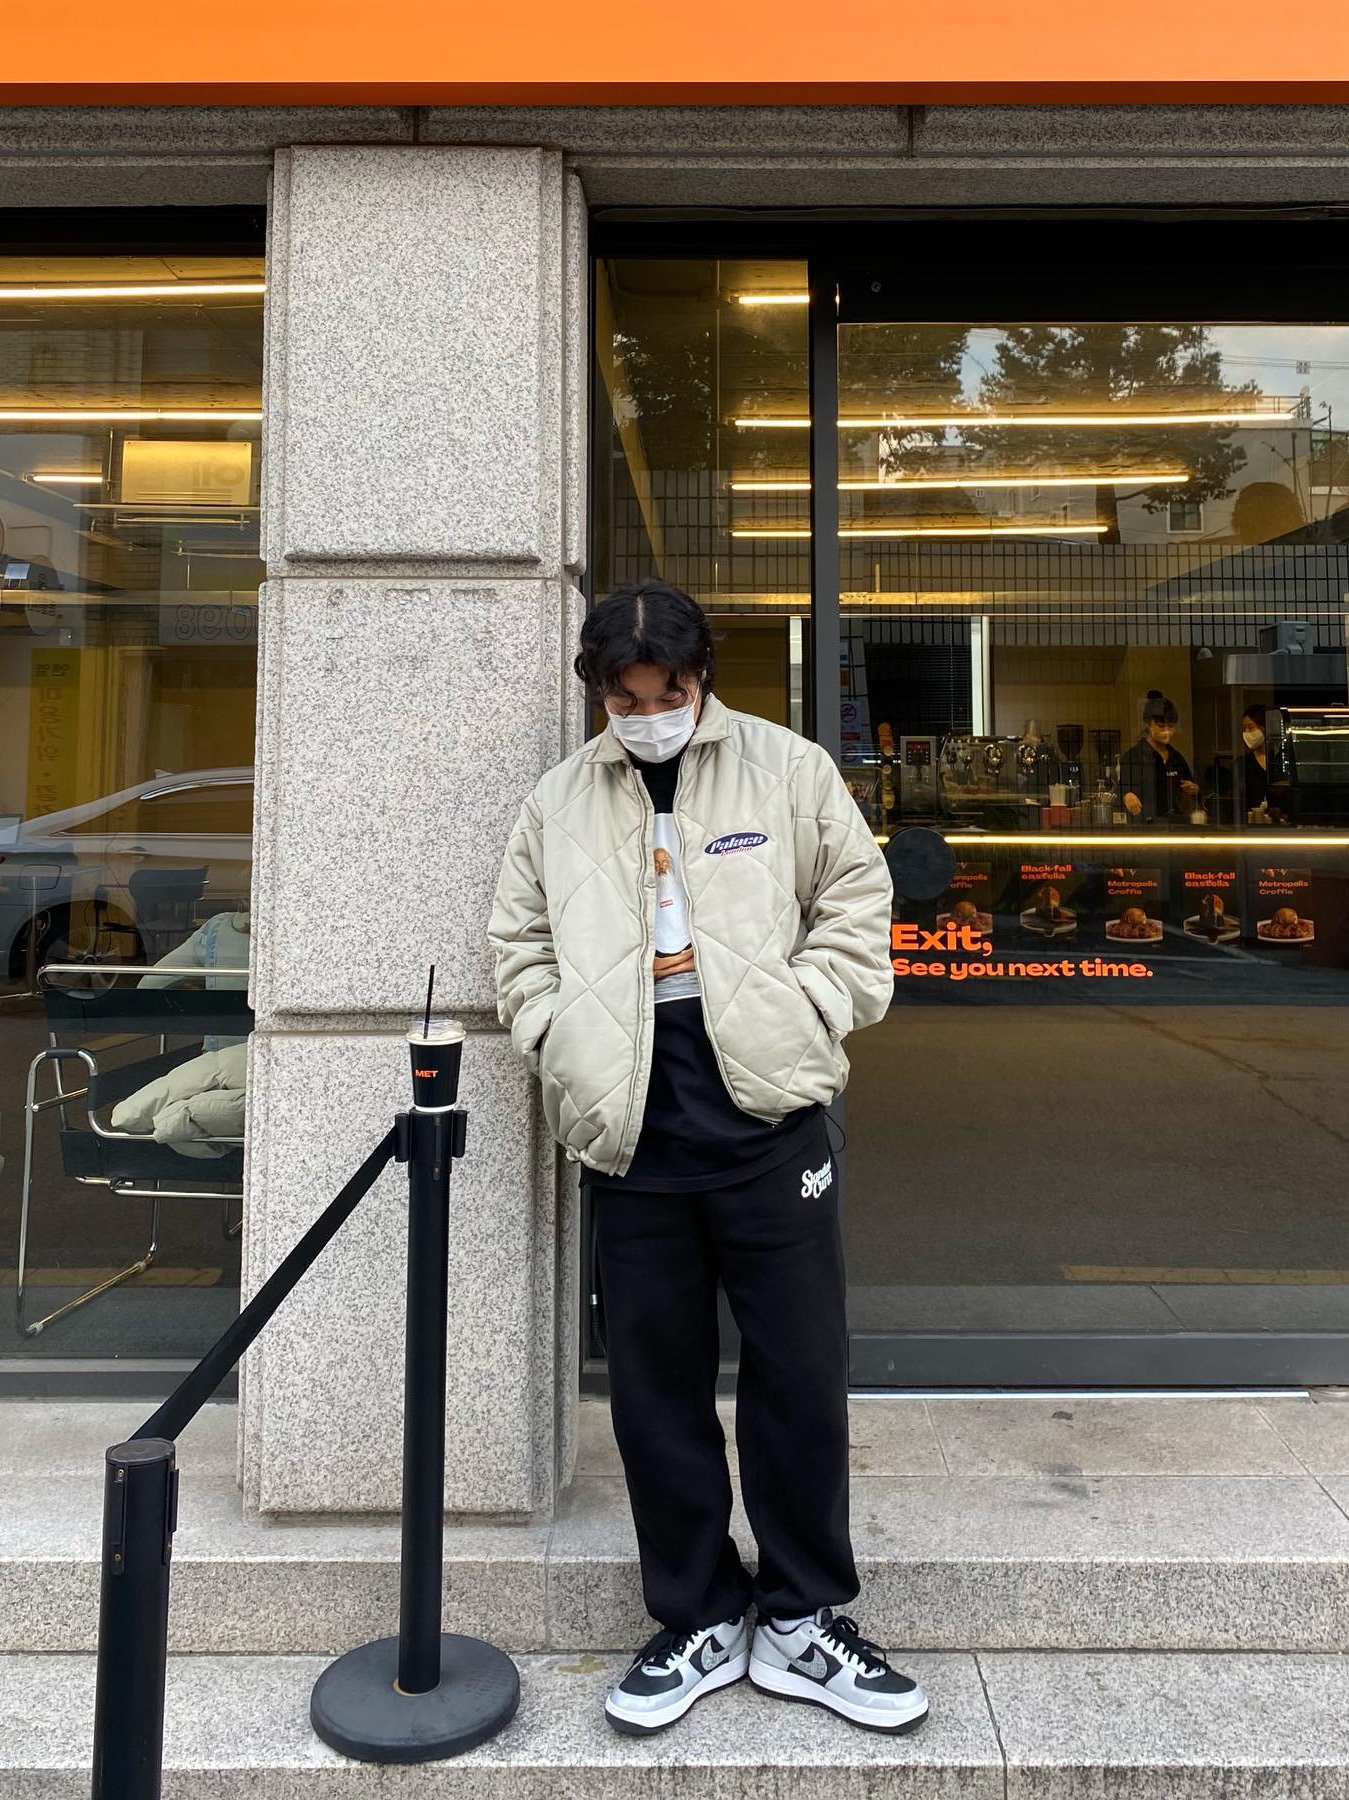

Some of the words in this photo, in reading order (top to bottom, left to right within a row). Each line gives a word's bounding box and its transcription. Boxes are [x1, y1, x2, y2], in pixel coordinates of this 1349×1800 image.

[709, 835, 764, 854] Palace
[1021, 864, 1072, 873] Black-fall
[1184, 872, 1236, 880] Black-fall
[891, 921, 993, 957] Exit,
[891, 958, 946, 977] See
[950, 962, 1004, 981] you
[1008, 959, 1075, 977] next
[1079, 957, 1154, 977] time.
[414, 1068, 439, 1078] MET
